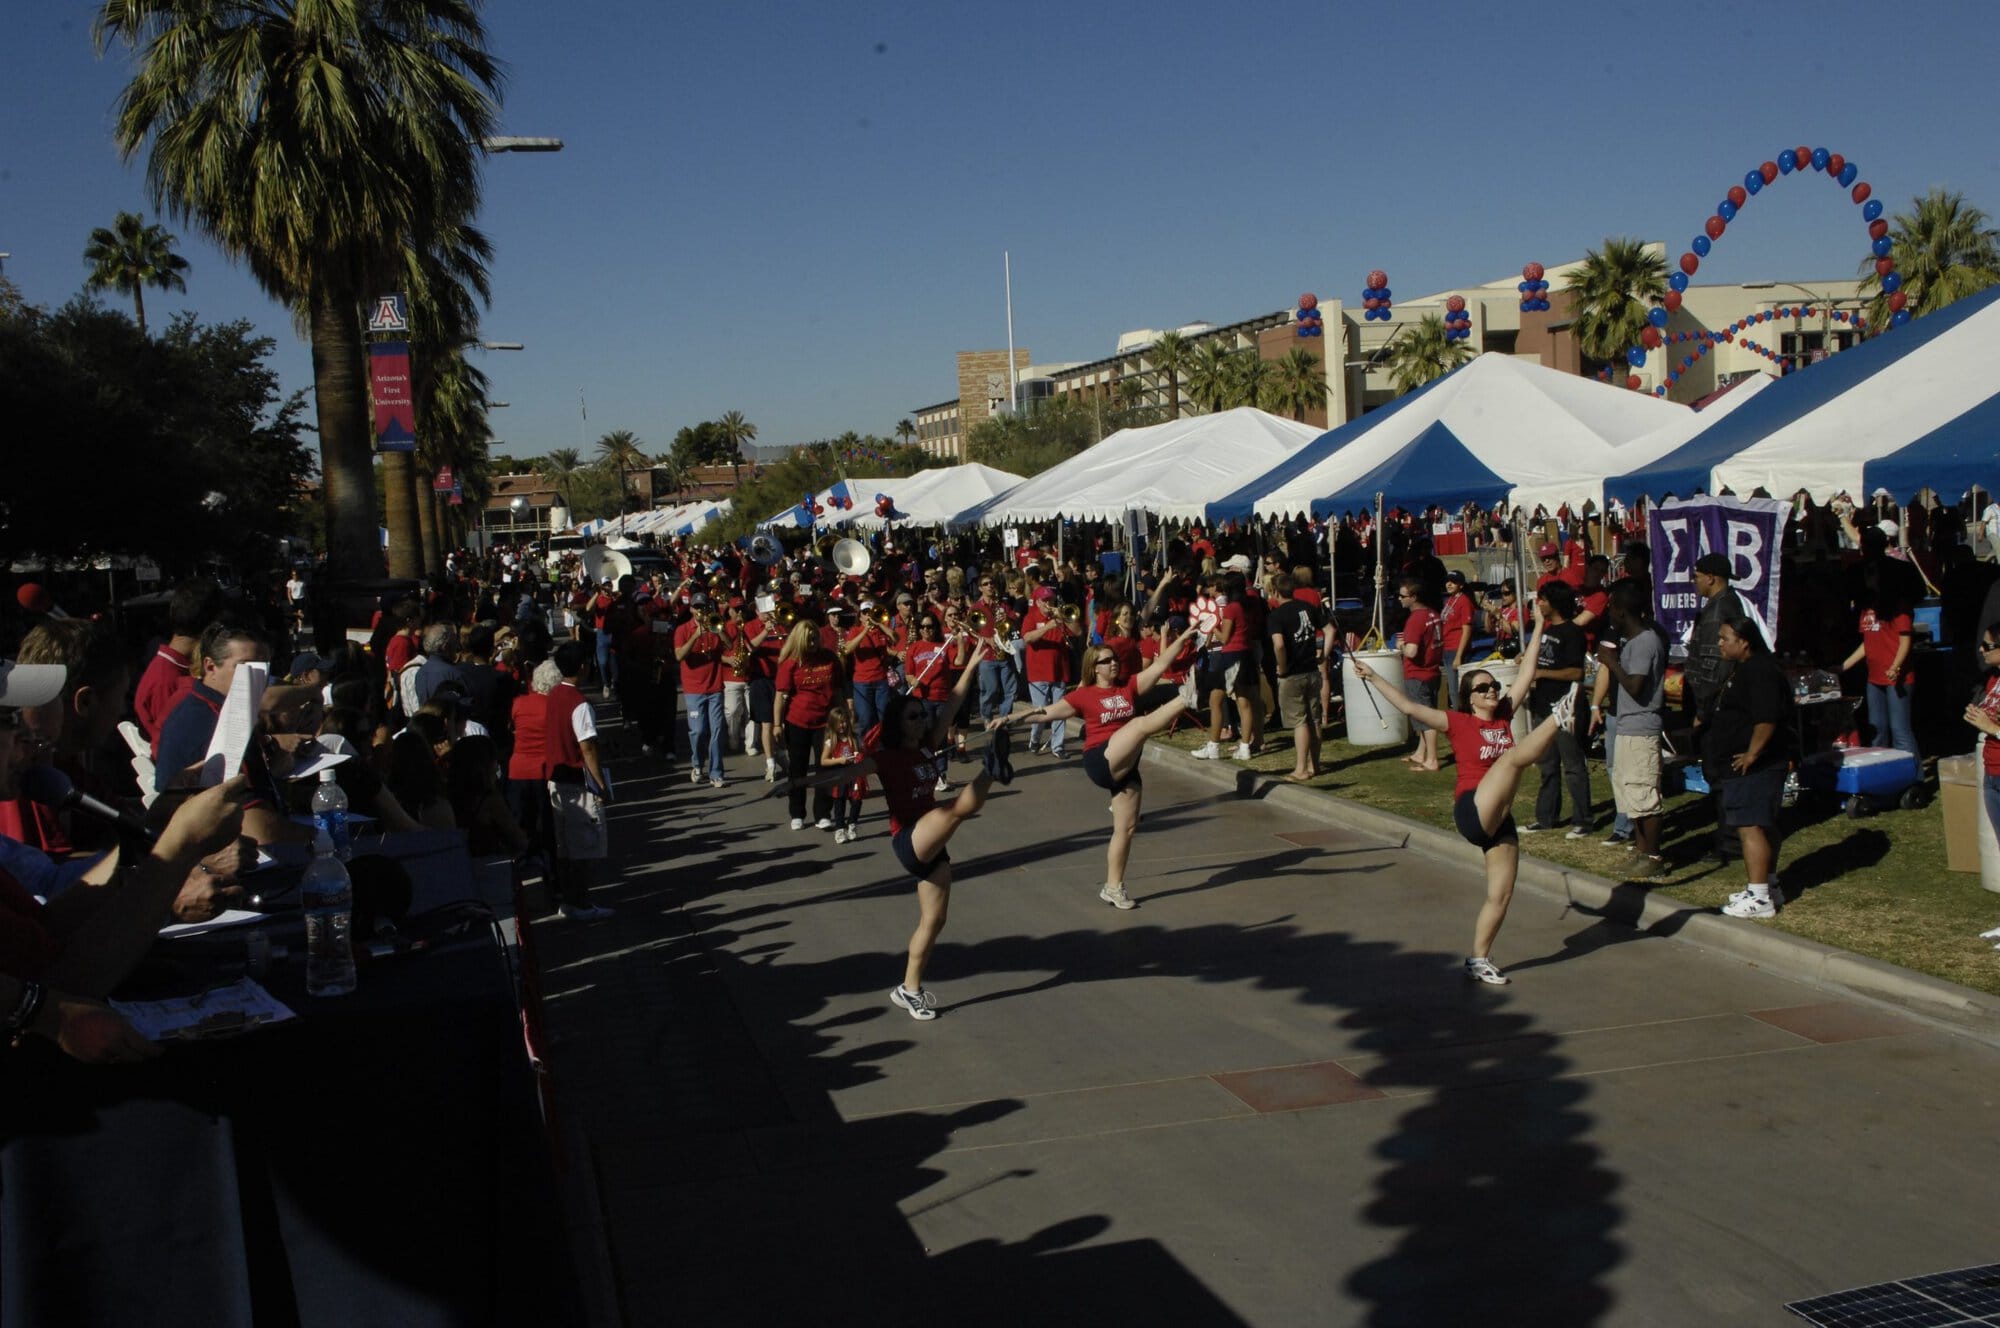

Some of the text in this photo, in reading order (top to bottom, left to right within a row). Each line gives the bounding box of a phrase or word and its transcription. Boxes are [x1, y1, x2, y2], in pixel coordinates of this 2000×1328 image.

[370, 297, 406, 330] A
[376, 374, 407, 382] Arizona's
[383, 386, 401, 394] First
[375, 398, 410, 407] University
